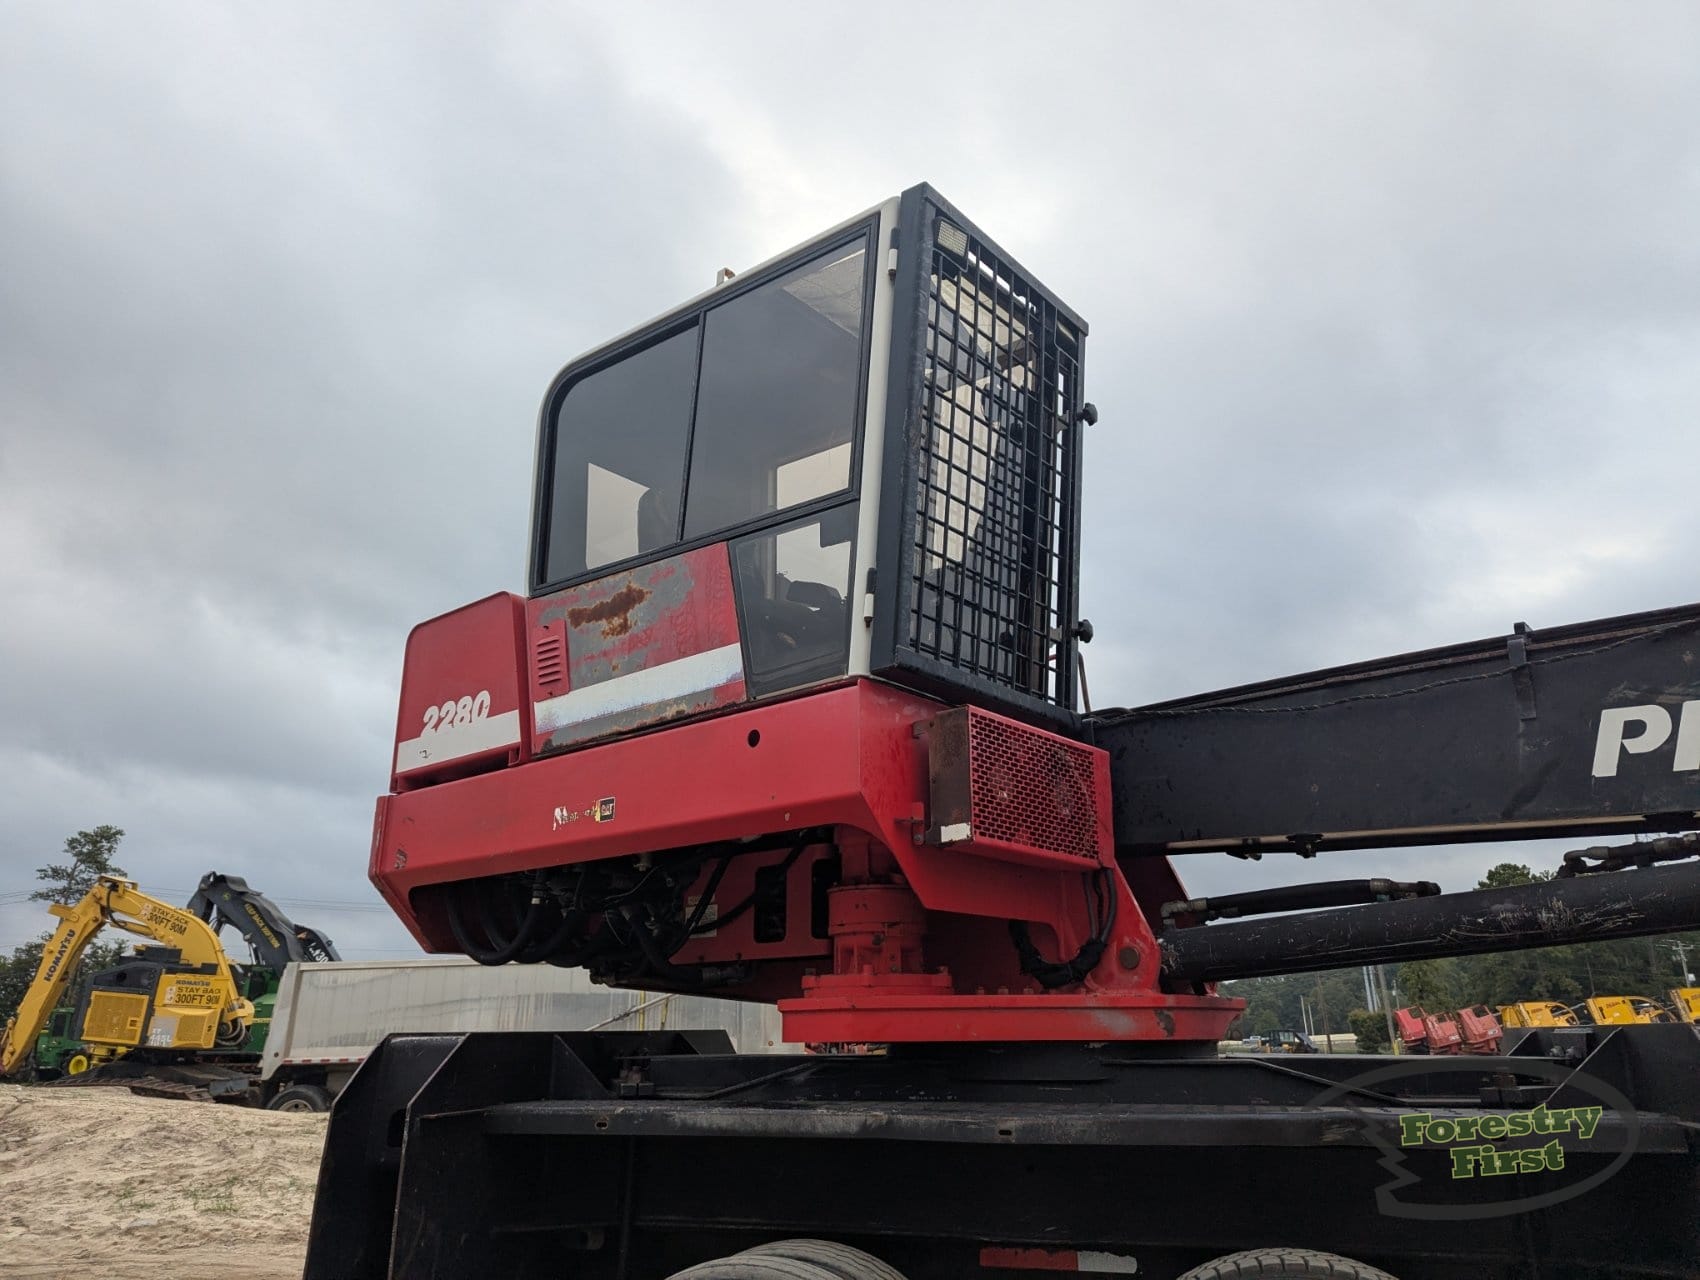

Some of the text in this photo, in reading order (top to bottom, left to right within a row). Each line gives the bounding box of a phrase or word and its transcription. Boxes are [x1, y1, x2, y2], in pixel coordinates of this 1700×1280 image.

[420, 689, 491, 738] 2280
[151, 906, 170, 918] STAY
[44, 928, 76, 982] KOMATSU
[176, 979, 210, 987] KOMATSU
[177, 986, 201, 994] STAY
[175, 993, 205, 1005] 300FT
